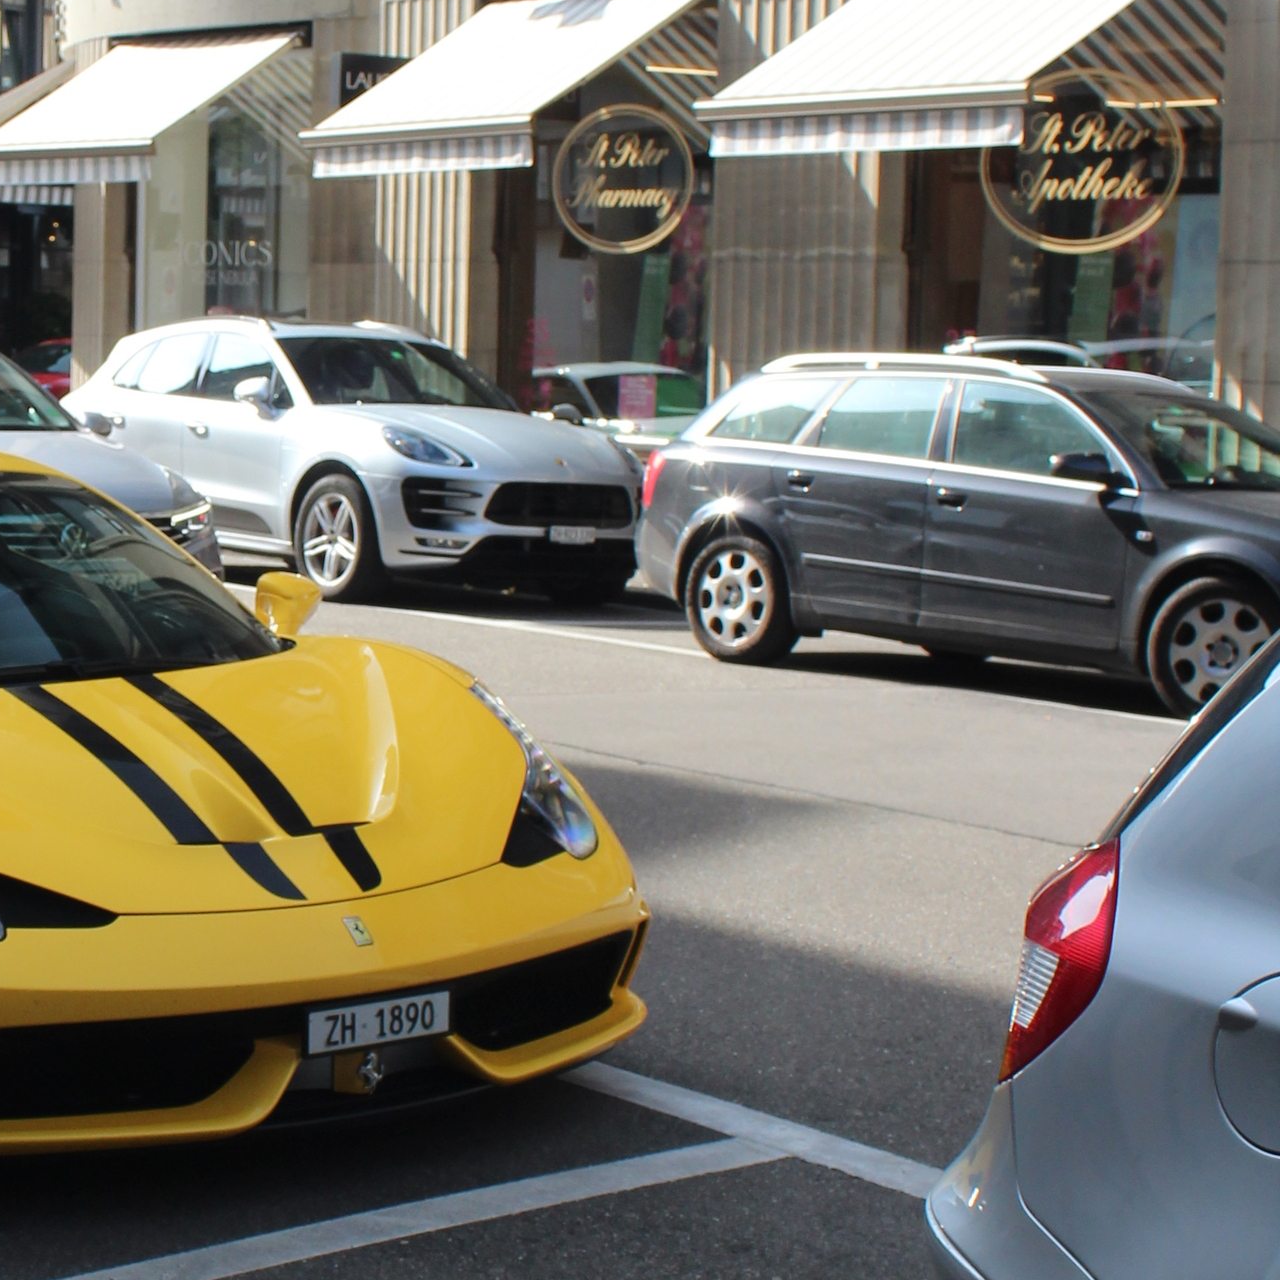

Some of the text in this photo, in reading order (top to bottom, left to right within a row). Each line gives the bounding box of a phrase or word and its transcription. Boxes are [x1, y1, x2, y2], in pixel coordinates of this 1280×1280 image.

[609, 131, 669, 168] Peter
[1064, 111, 1152, 154] Peter
[565, 174, 679, 220] Pharmacy
[1011, 157, 1154, 215] Apotheke
[325, 1000, 435, 1047] ZH 1890
